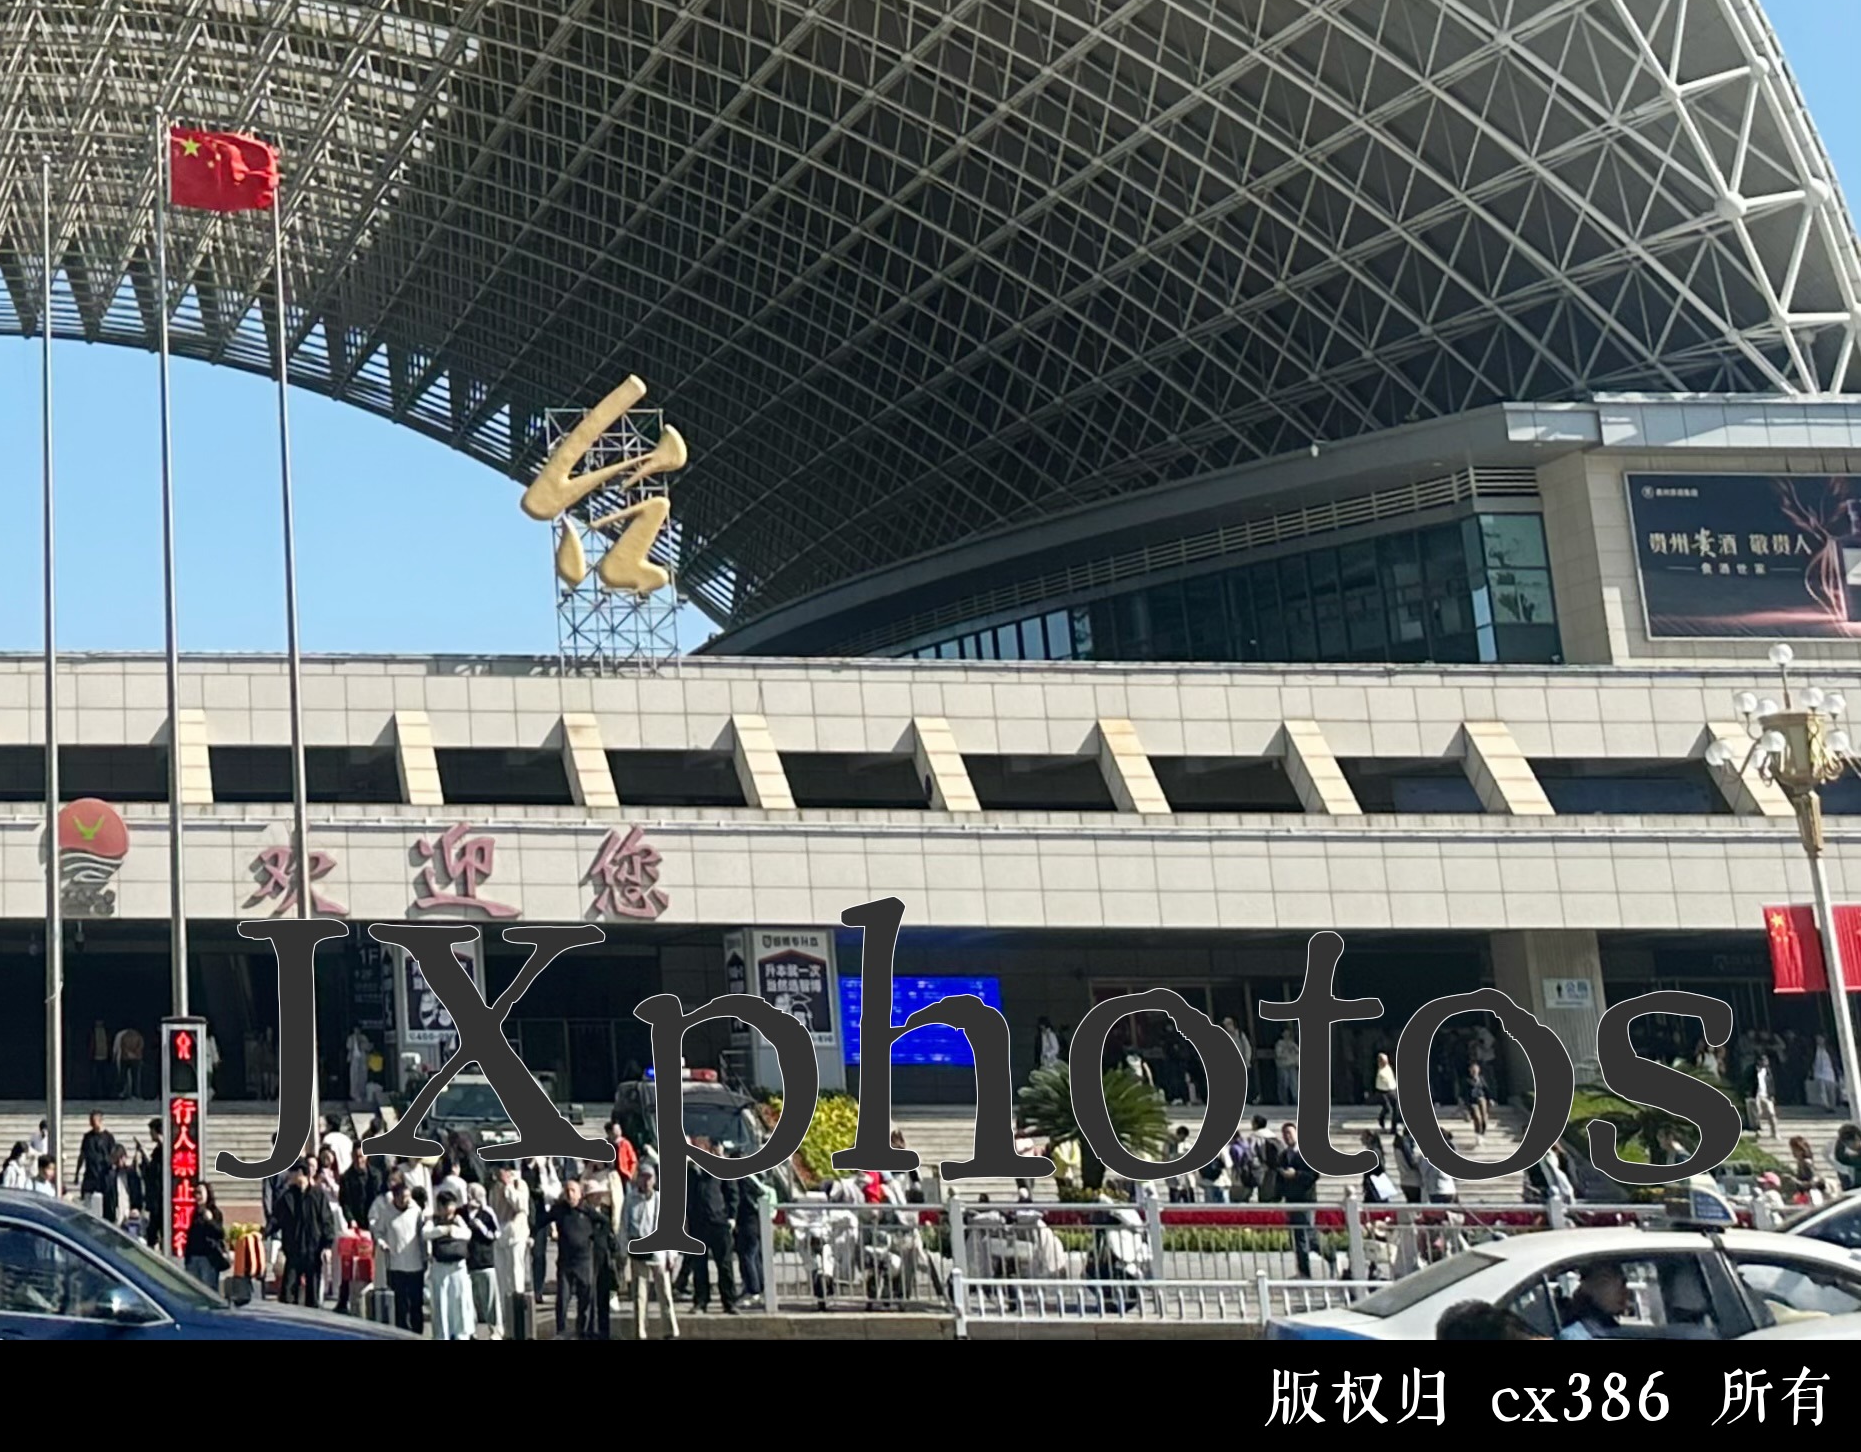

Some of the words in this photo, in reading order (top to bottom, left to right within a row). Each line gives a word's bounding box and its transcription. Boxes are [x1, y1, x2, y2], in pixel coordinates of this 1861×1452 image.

[1748, 533, 1813, 557] 敬贵人
[250, 821, 670, 919] 欢迎您
